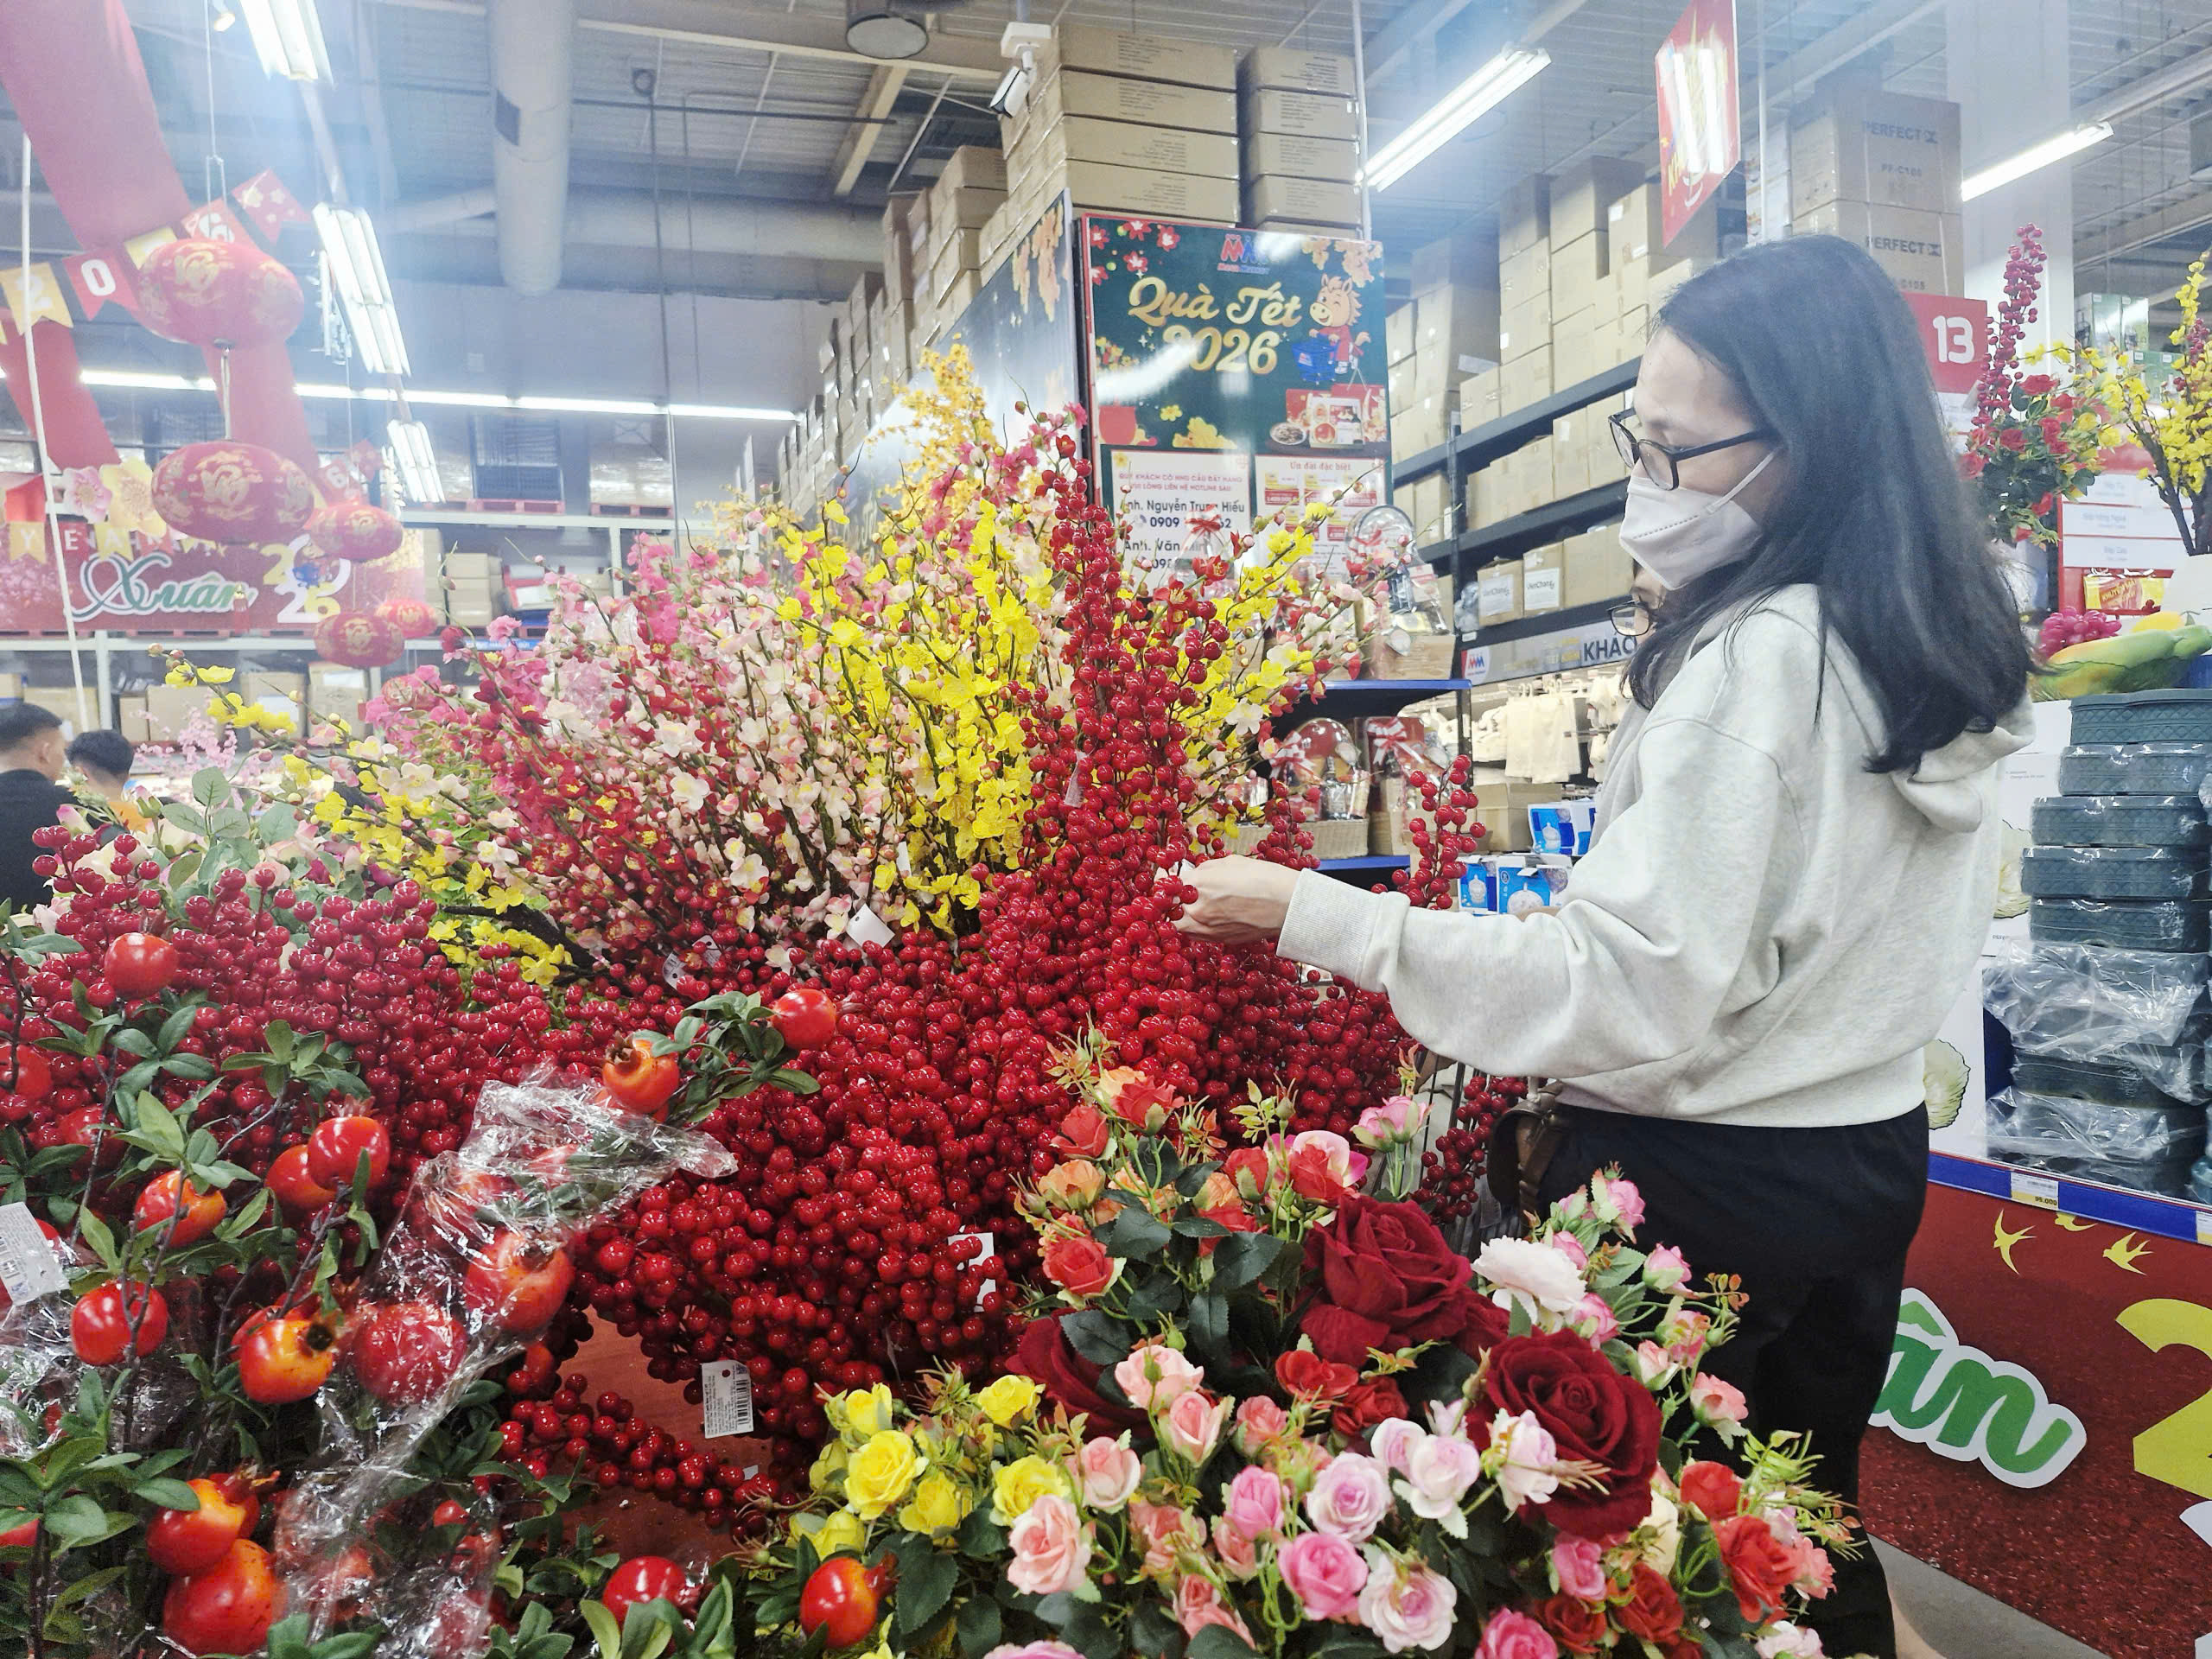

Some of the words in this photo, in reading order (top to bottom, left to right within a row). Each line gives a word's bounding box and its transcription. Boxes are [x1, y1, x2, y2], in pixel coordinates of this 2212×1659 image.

[1866, 235, 1925, 254] PERFECT
[1128, 276, 1220, 327] Quà
[1226, 282, 1302, 327] Tết
[1932, 315, 1975, 364] 13
[1147, 498, 1187, 513] Nguyễn
[1222, 499, 1244, 512] Hiếu
[1150, 517, 1179, 528] 0909
[63, 551, 258, 622] Xuân
